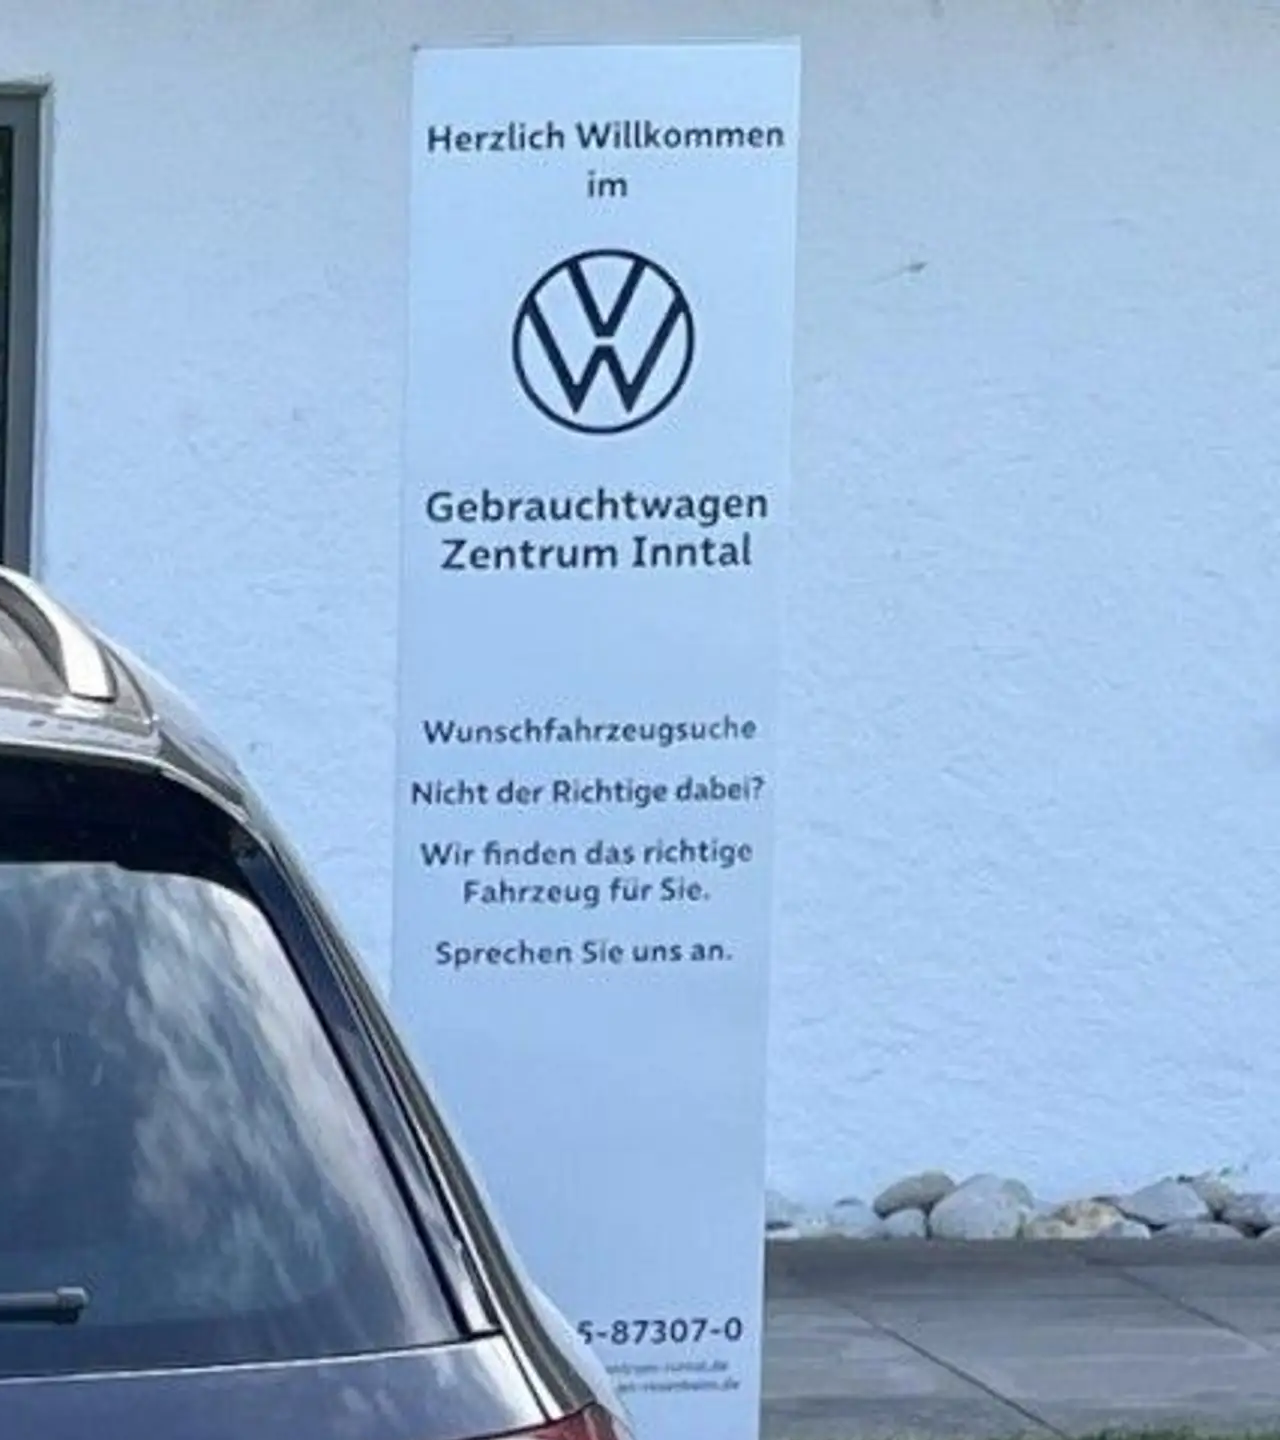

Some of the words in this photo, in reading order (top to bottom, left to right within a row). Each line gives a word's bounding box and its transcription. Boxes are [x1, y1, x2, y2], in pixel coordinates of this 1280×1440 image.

[428, 121, 565, 153] Herzlich
[575, 120, 784, 149] Willkommen
[588, 170, 627, 197] im
[426, 487, 767, 529] Gebrauchtwagen
[441, 539, 617, 570] Zentrum
[632, 532, 751, 568] Inntal
[423, 715, 756, 748] Wunschfahrzeugsuche
[412, 780, 488, 805] Nicht
[496, 780, 544, 805] der
[553, 778, 667, 808] Richtige
[675, 775, 765, 802] dabei?
[420, 843, 474, 866] Wir
[483, 840, 576, 865] finden
[585, 840, 635, 865] das
[644, 838, 752, 869] richtige
[464, 879, 600, 909] Fahrzeug
[609, 877, 653, 902] für
[660, 877, 709, 901] Sie.
[436, 939, 572, 970] Sprechen
[582, 940, 624, 964] Sie
[632, 945, 682, 962] uns
[691, 943, 732, 961] an.
